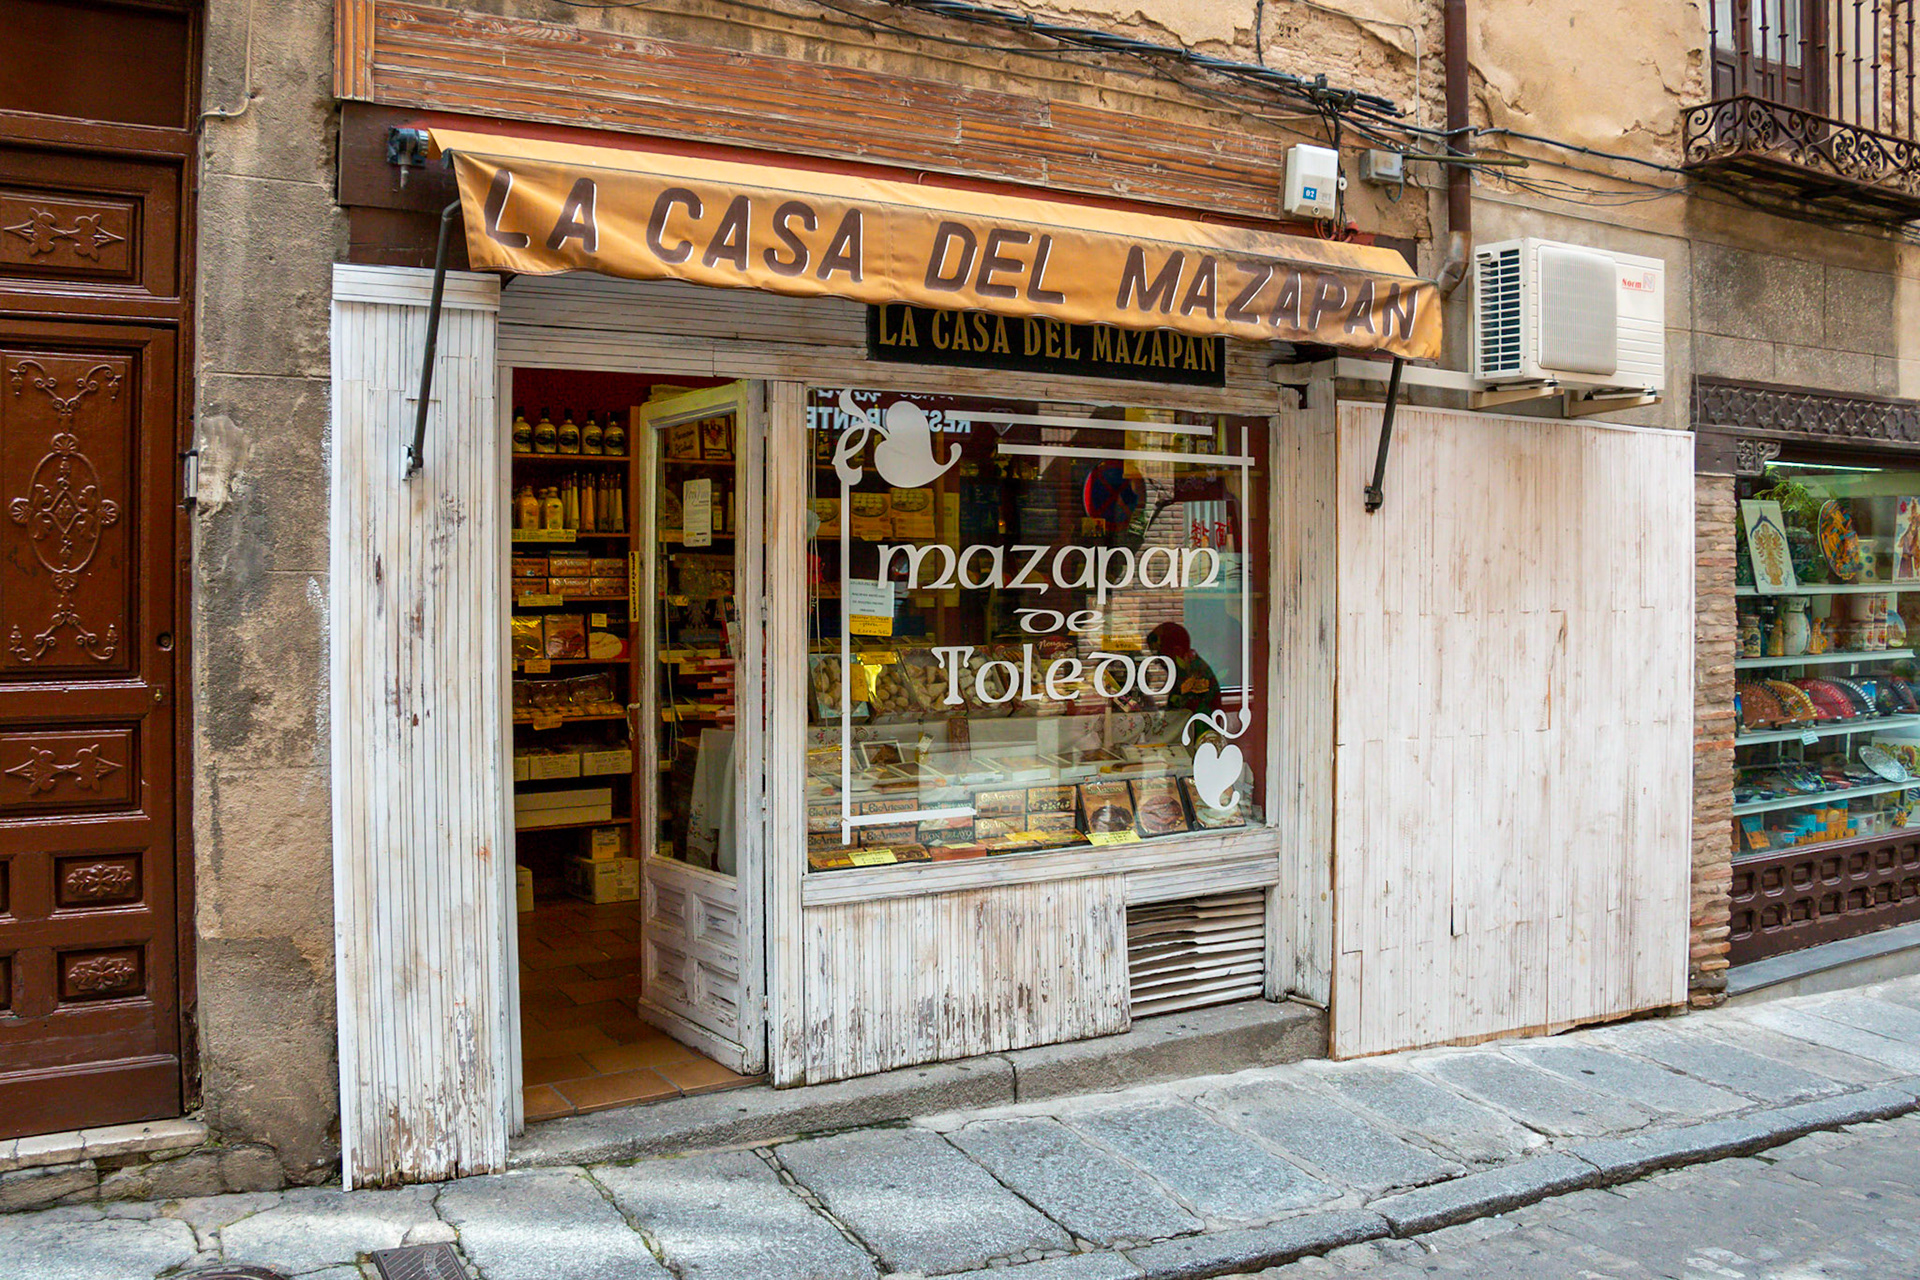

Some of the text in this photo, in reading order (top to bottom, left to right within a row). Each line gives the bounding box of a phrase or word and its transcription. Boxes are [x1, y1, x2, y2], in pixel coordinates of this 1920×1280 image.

[484, 169, 1421, 341] LA CASA DEL MAZAPAN
[1621, 278, 1642, 288] Norm
[879, 304, 1216, 372] LA CASA DEL MAZAPAN
[877, 544, 1219, 605] mazapan
[1013, 608, 1106, 633] de
[931, 644, 1177, 706] Toledo
